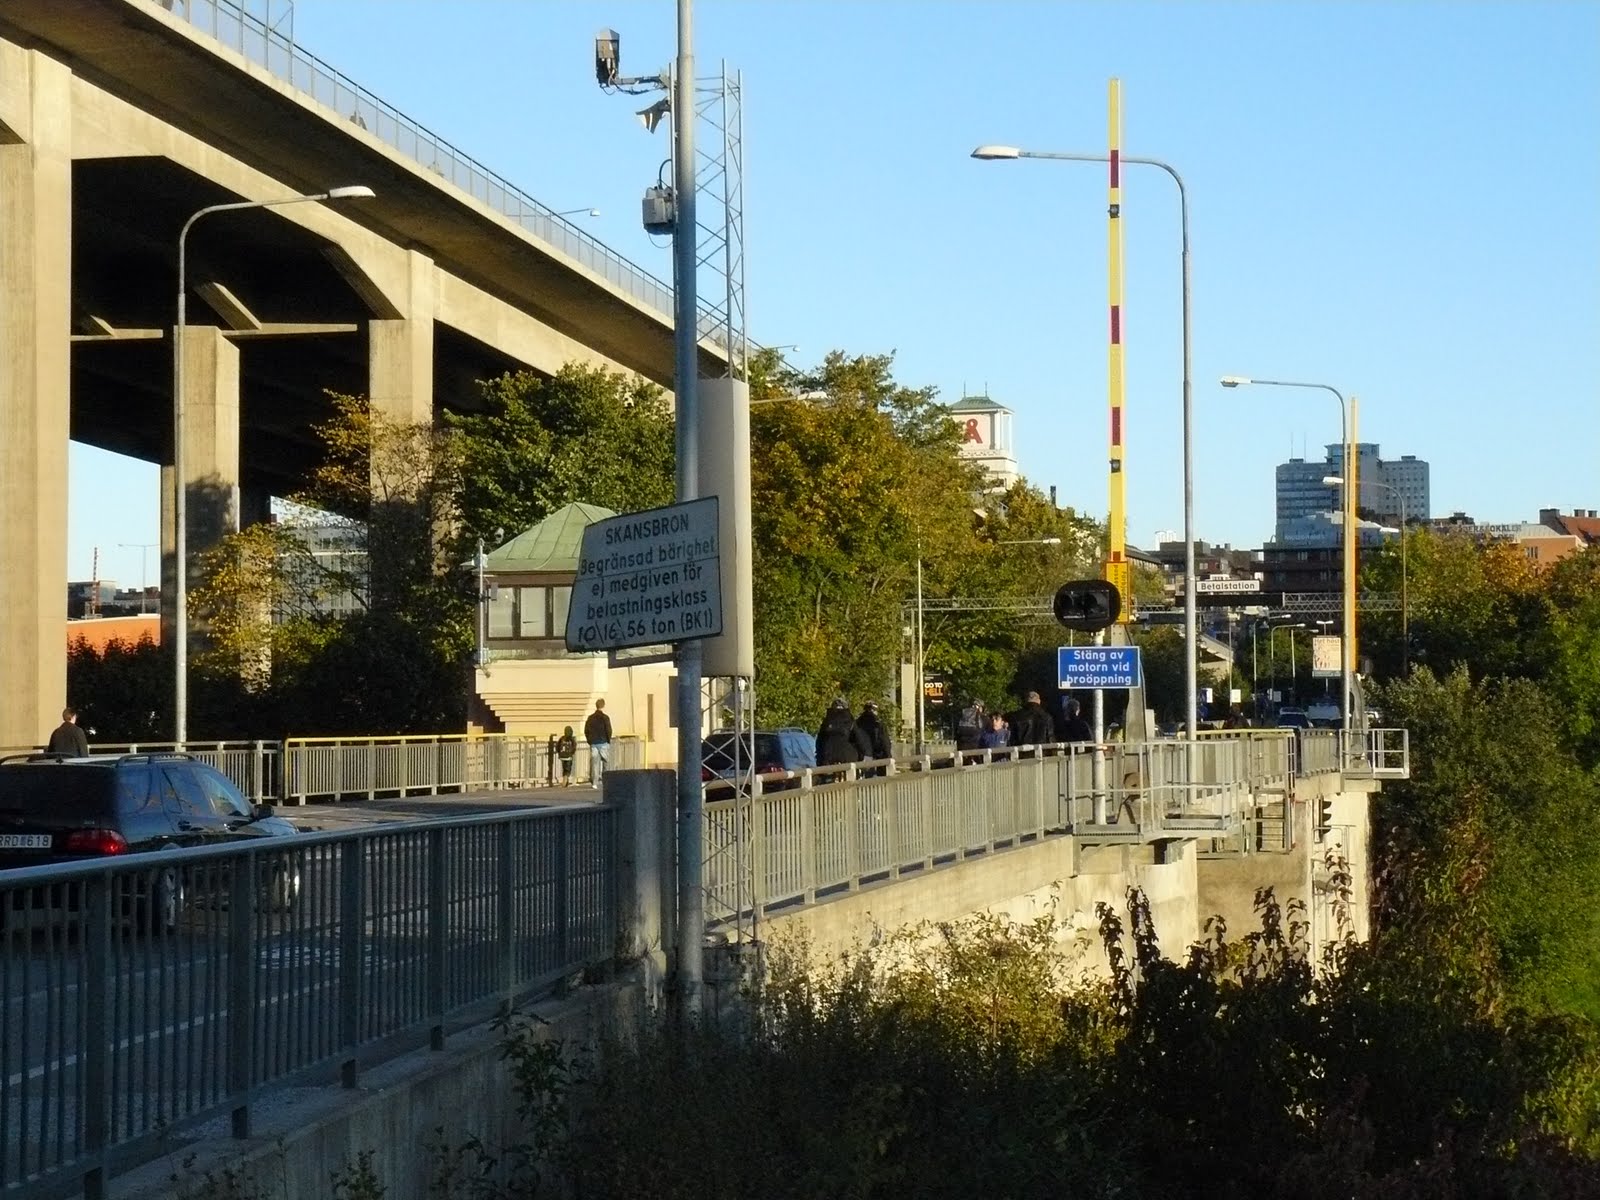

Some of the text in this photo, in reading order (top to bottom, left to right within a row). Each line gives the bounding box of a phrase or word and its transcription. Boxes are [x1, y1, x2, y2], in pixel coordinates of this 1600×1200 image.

[605, 513, 689, 545] SKANSBRON
[580, 535, 715, 577] Begränsad bärighet
[591, 561, 703, 599] ej medgiven för
[1200, 582, 1255, 590] Betalstation
[587, 589, 707, 620] belastningsklass
[651, 618, 675, 635] ton
[680, 608, 713, 632] (BK1)
[1073, 650, 1124, 662] Stäng av
[1068, 661, 1130, 672] motorn vid
[1066, 673, 1132, 686] broöppning
[924, 687, 944, 696] HELL
